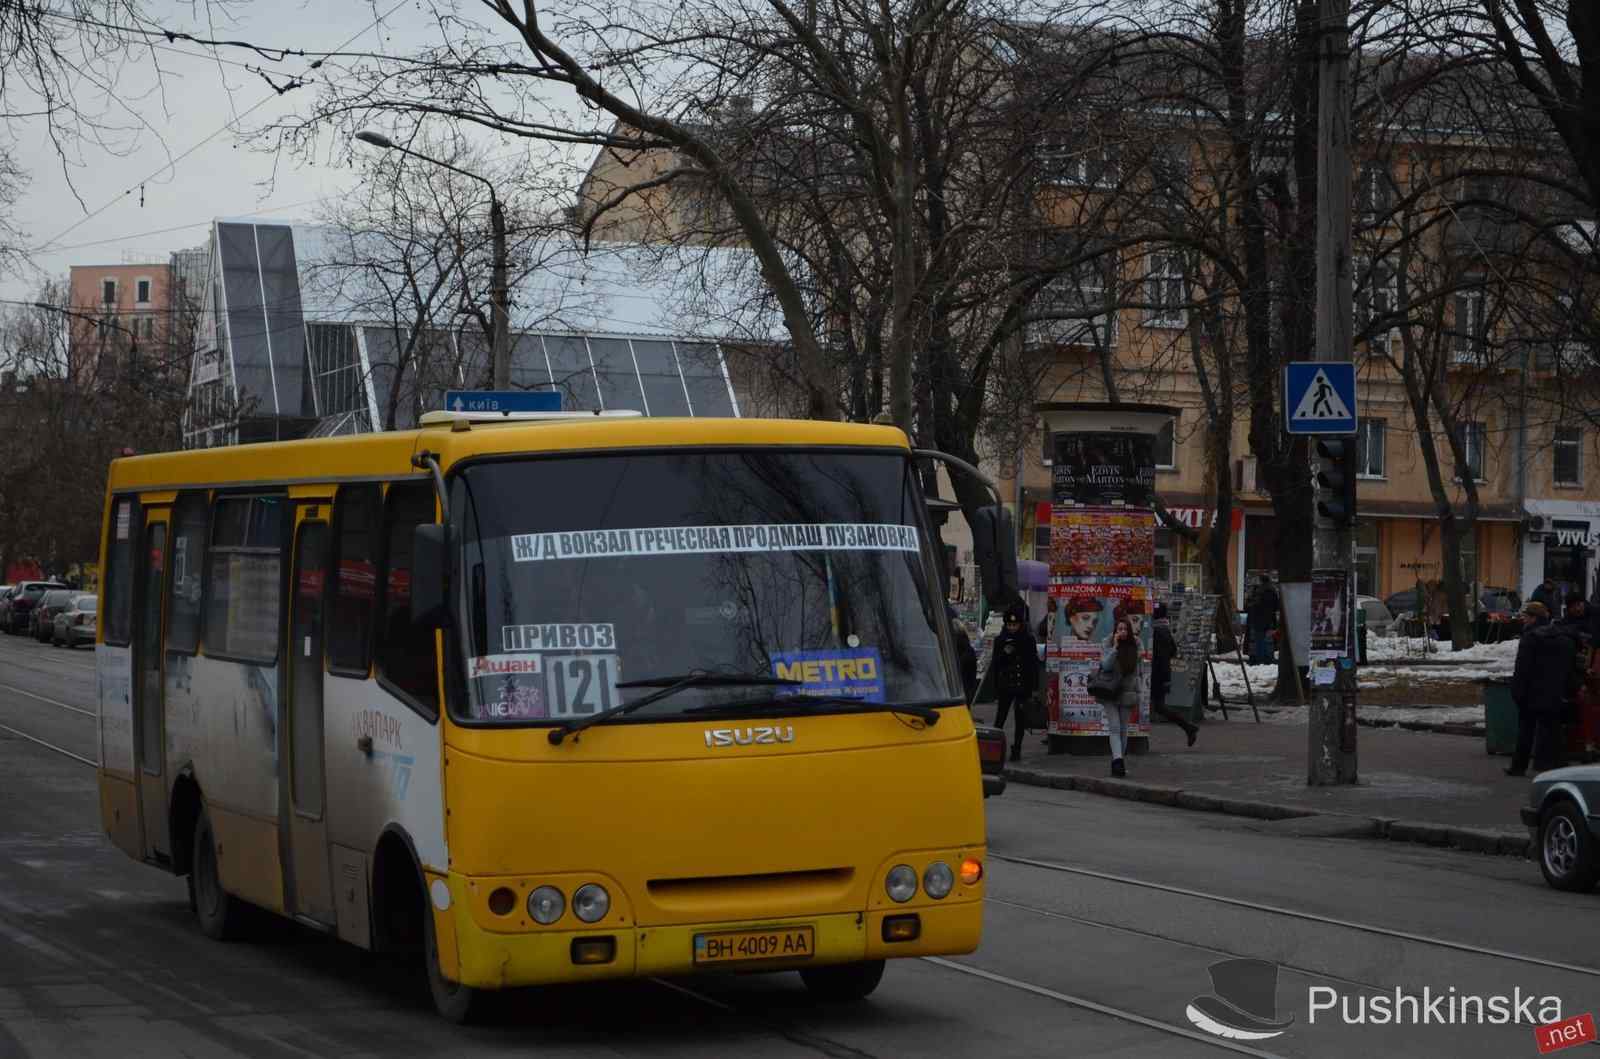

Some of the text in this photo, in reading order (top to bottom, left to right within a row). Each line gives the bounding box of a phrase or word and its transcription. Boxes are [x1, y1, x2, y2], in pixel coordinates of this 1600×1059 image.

[514, 525, 918, 560] Ж/Д ВОКЗАЛ ГРЕЧЕСКАЯ ПРОДМАШ ЛУЗАНОВКА
[504, 624, 613, 649] ПРИВОЗ
[775, 657, 877, 683] METRO
[553, 658, 612, 713] 121
[704, 725, 793, 747] ISUZU
[707, 932, 808, 958] BH 4009 AA
